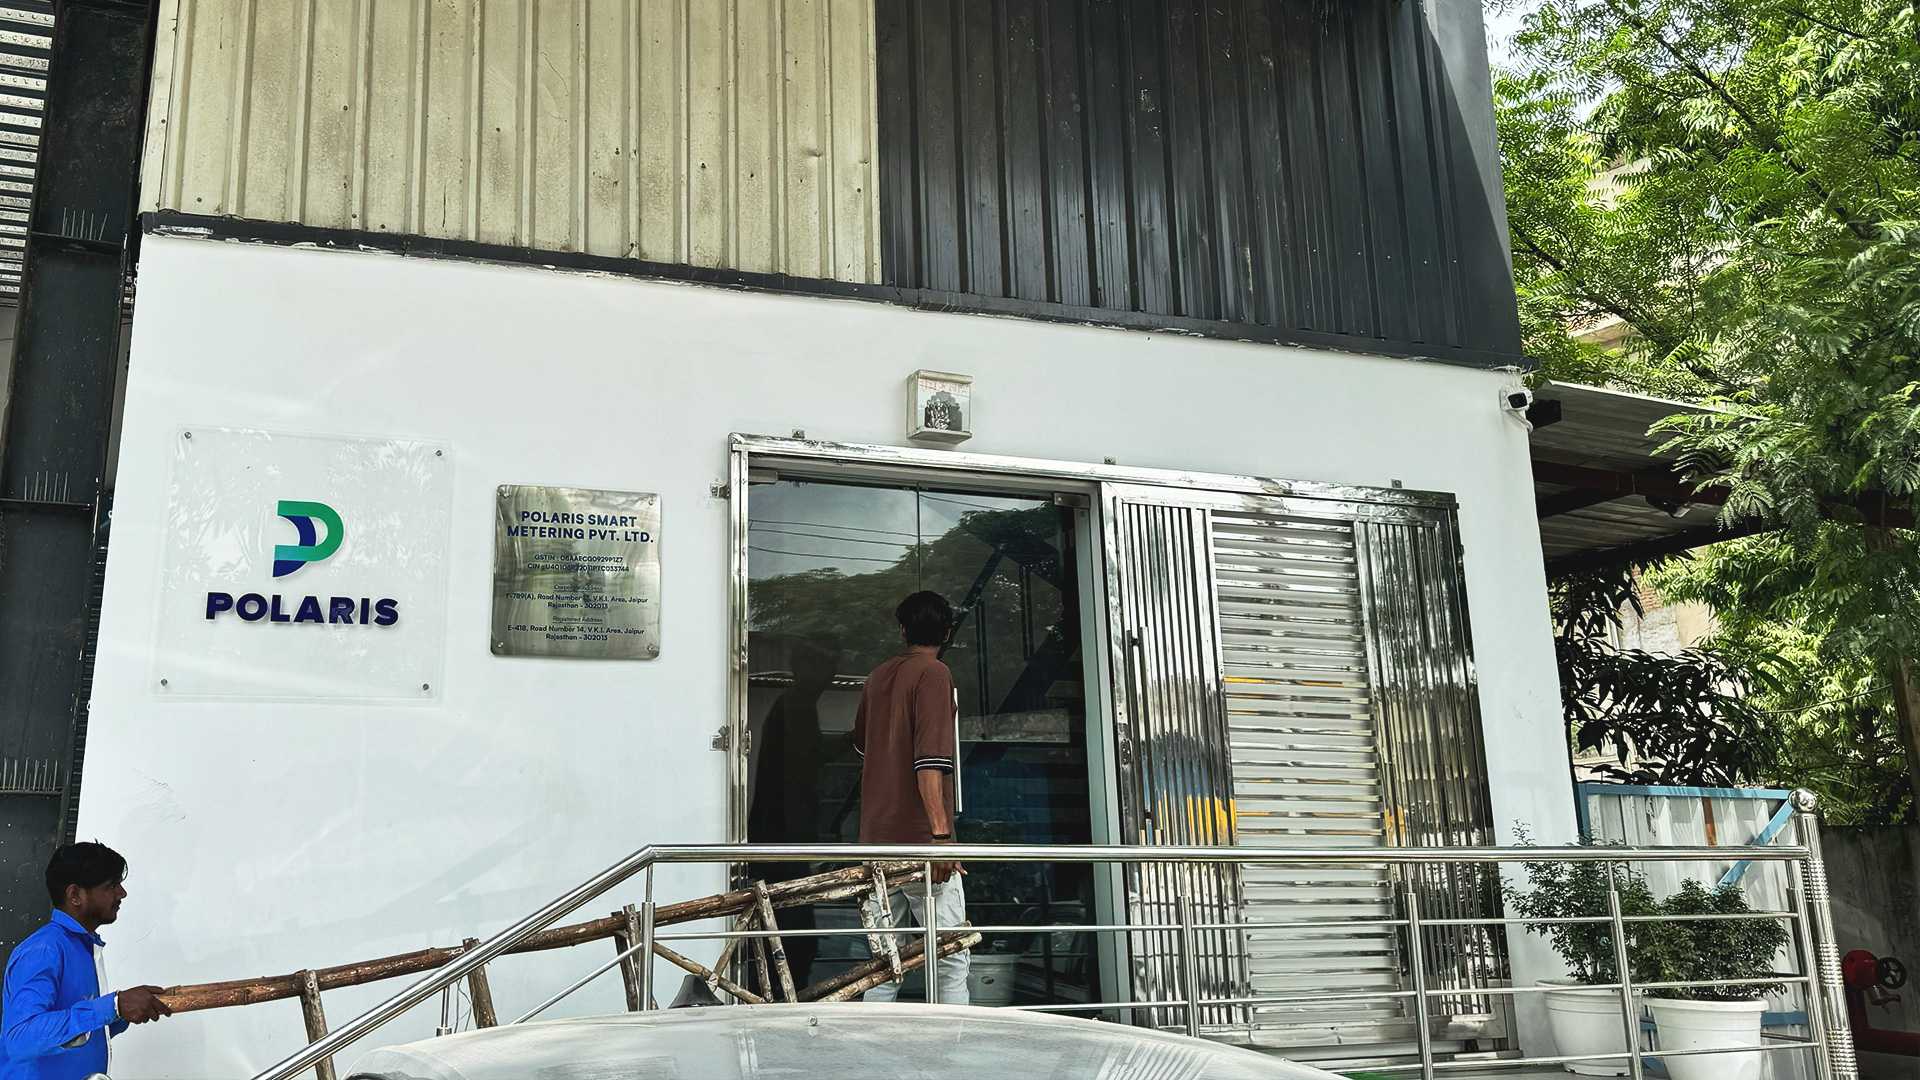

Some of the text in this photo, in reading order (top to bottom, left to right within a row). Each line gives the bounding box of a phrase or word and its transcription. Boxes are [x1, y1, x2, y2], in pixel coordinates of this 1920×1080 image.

[521, 510, 638, 527] POLARIS SMART
[507, 525, 654, 543] METERING PVT. LTD.
[205, 591, 400, 627] POLARIS
[530, 624, 547, 632] Road
